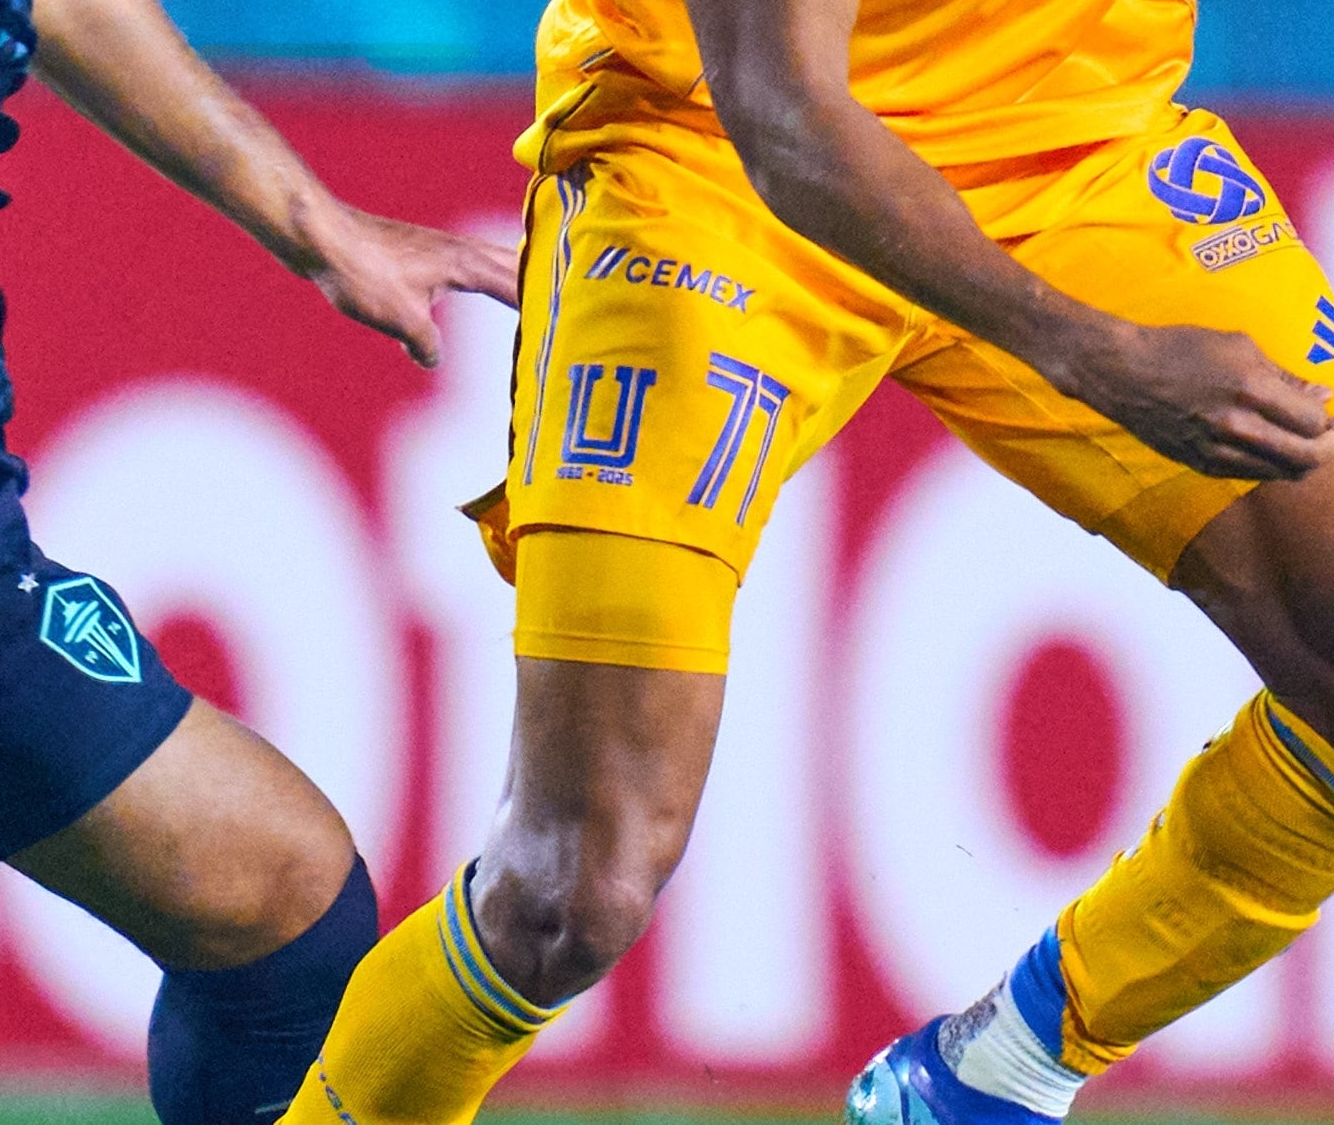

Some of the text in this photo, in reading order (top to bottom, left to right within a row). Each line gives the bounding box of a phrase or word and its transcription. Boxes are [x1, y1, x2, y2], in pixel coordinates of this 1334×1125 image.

[1198, 222, 1298, 268] OXXO GA
[624, 255, 756, 315] CEMEX
[561, 363, 658, 469] U
